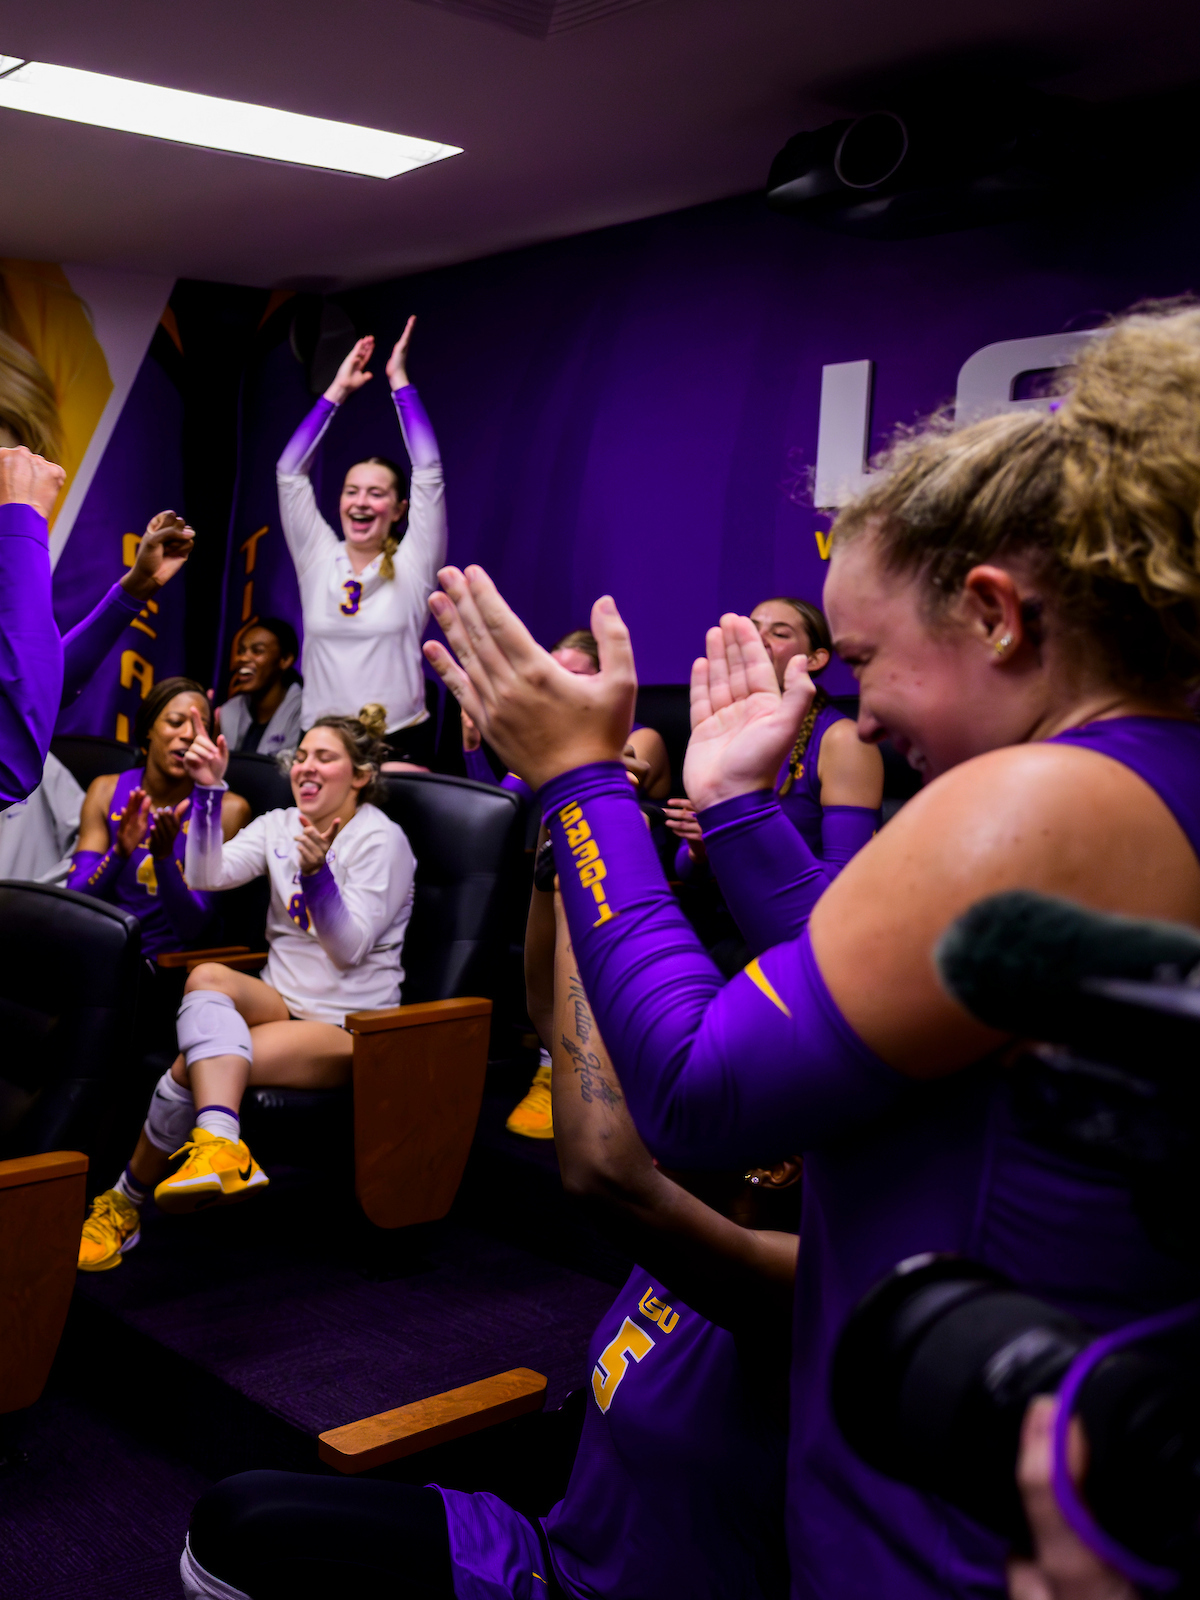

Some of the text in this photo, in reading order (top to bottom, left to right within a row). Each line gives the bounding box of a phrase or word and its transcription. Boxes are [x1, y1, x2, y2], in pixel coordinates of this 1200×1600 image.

[340, 579, 363, 616] 3
[558, 800, 620, 928] TIGERS
[638, 1286, 680, 1334] LSU
[591, 1316, 656, 1415] 5
